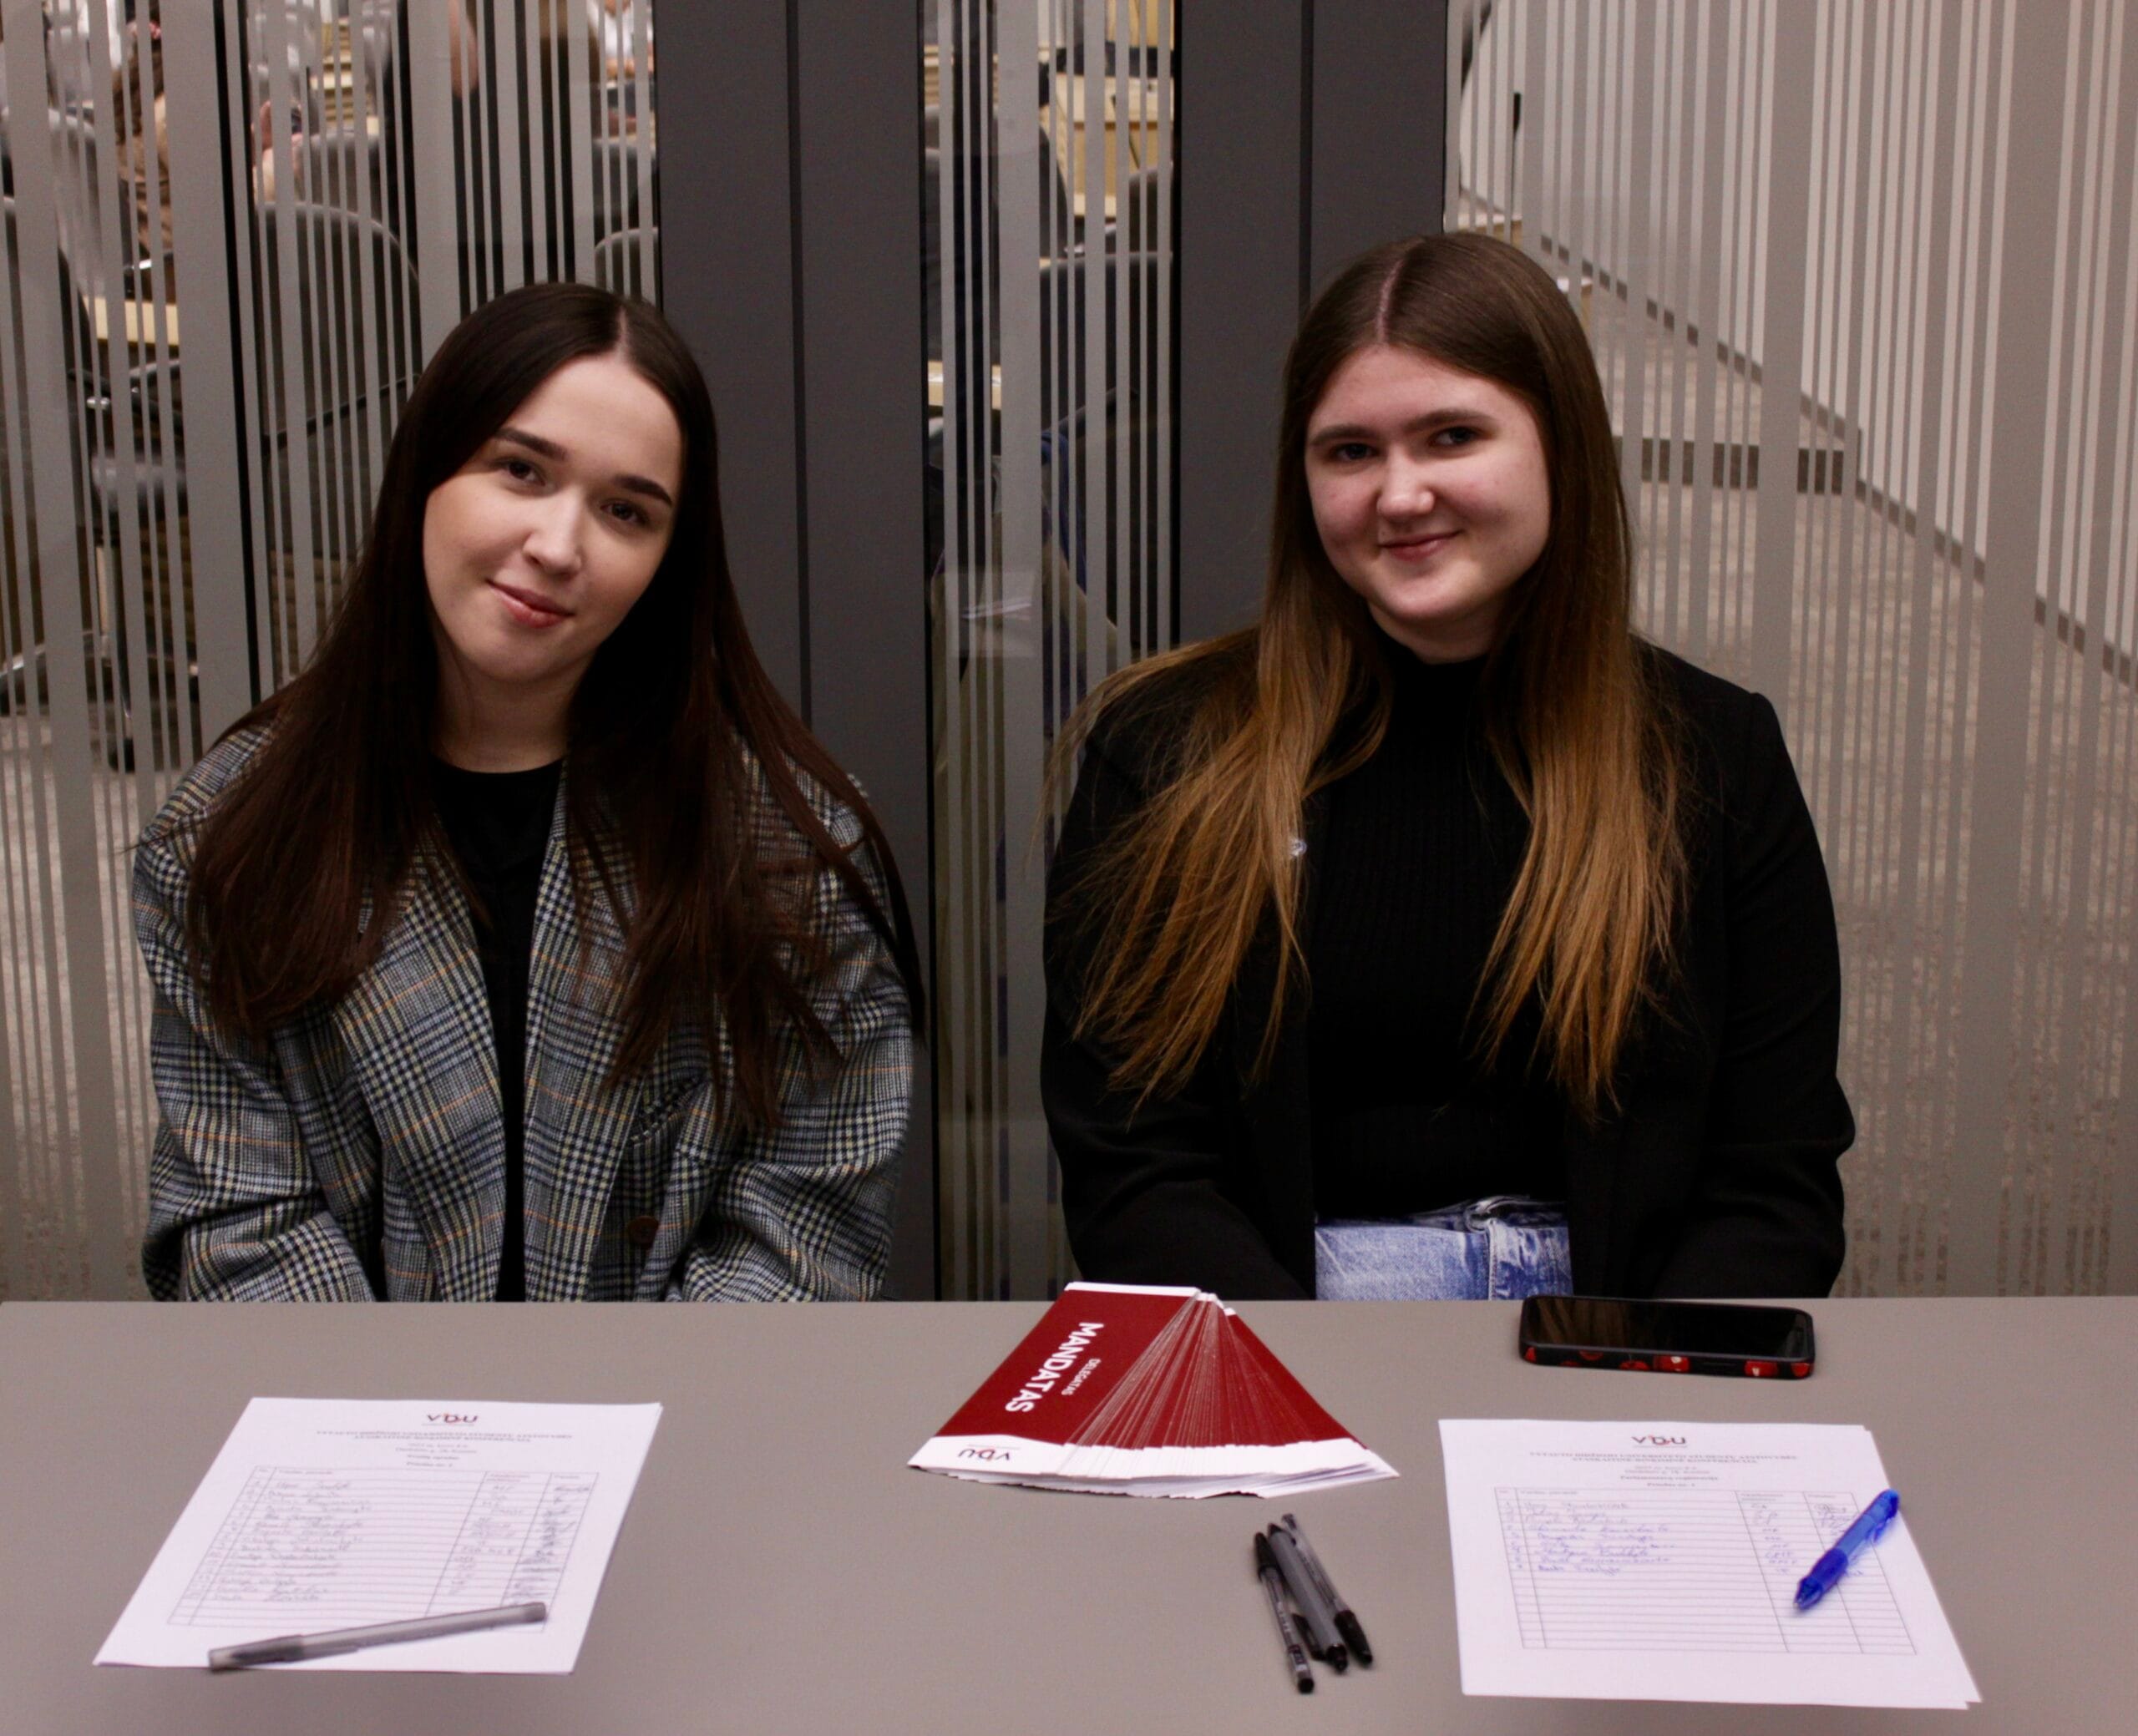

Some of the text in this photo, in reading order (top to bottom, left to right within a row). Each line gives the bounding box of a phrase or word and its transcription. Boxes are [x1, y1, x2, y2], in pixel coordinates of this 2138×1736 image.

[1005, 1322, 1104, 1413] MANDATAS
[1061, 1358, 1102, 1396] DELEGATAS
[427, 1413, 479, 1424] VDU
[1631, 1435, 1686, 1445] VDU
[958, 1448, 1011, 1460] VDU
